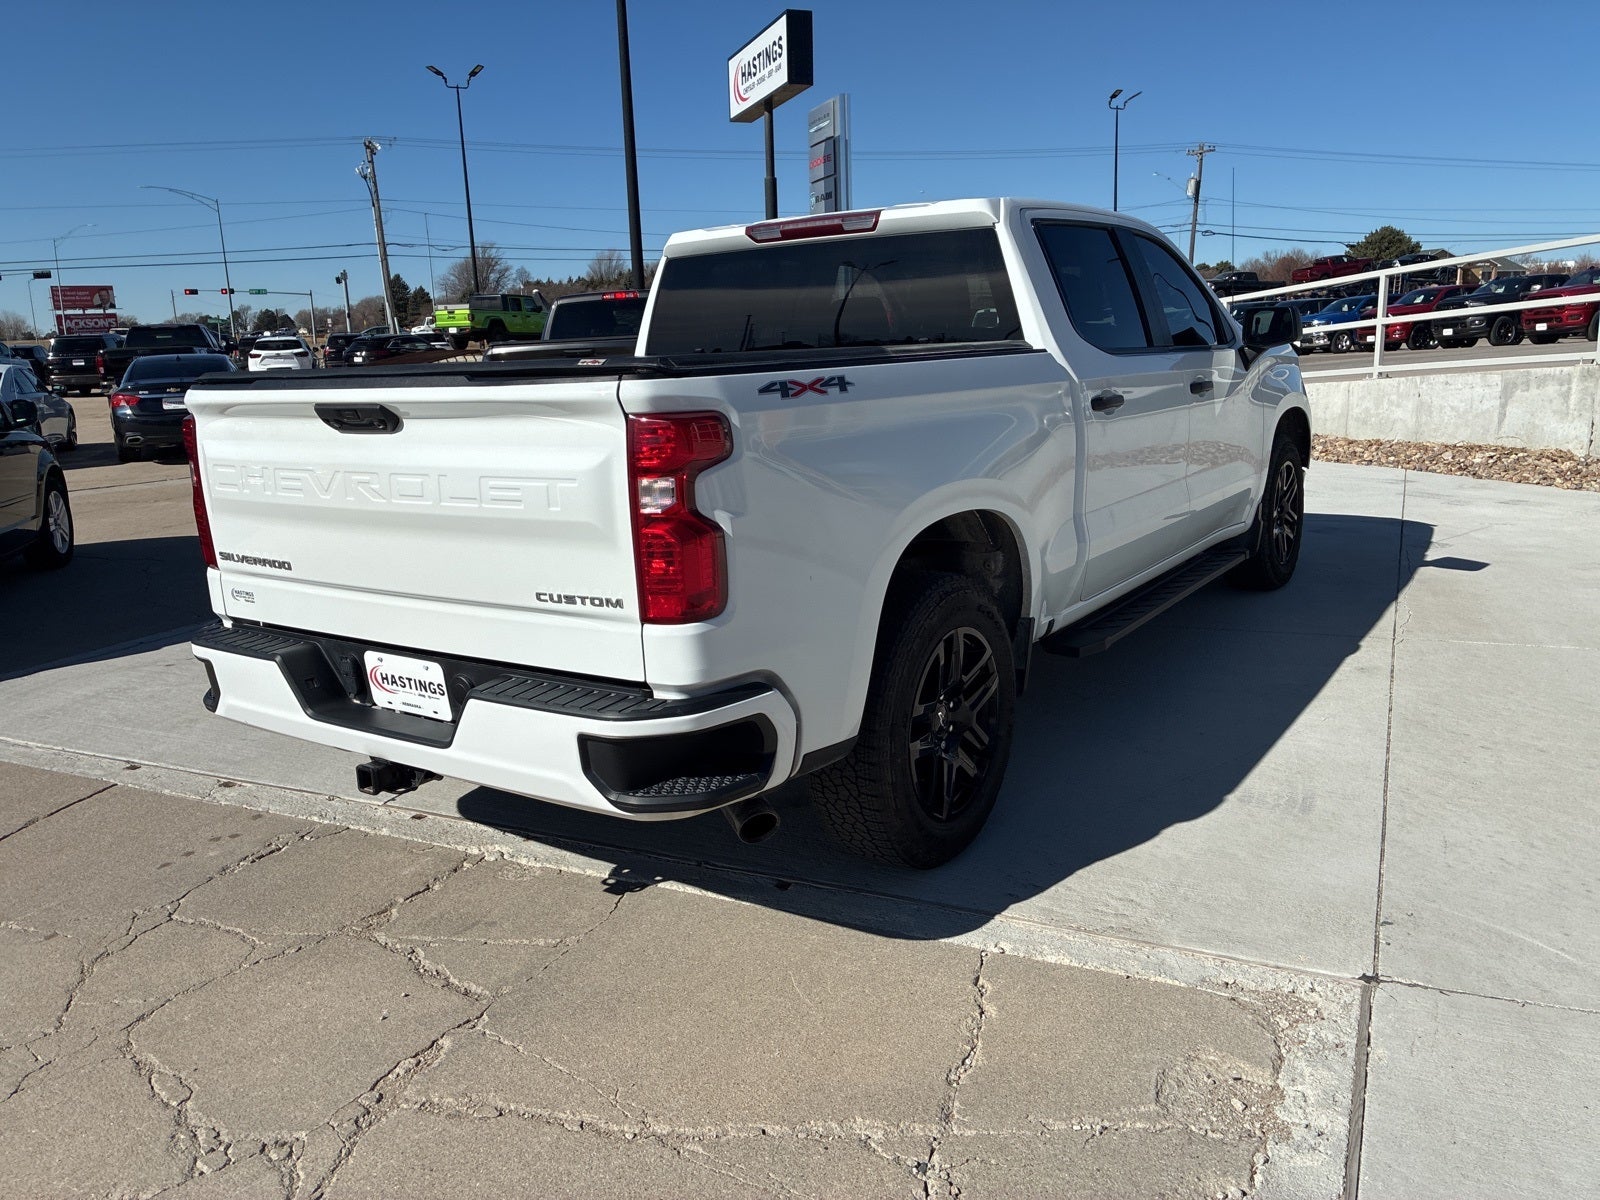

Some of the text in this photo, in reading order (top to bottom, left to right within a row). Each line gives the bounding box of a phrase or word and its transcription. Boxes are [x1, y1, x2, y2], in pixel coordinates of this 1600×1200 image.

[740, 35, 783, 86] HASTINGS
[809, 153, 832, 170] DODGE
[815, 191, 833, 204] RAM
[61, 317, 117, 330] ACKSON'S
[211, 463, 579, 512] CHEVROLET
[218, 551, 293, 571] SILVERADO
[535, 591, 624, 609] CUSTOM
[379, 671, 446, 697] HASTINGS
